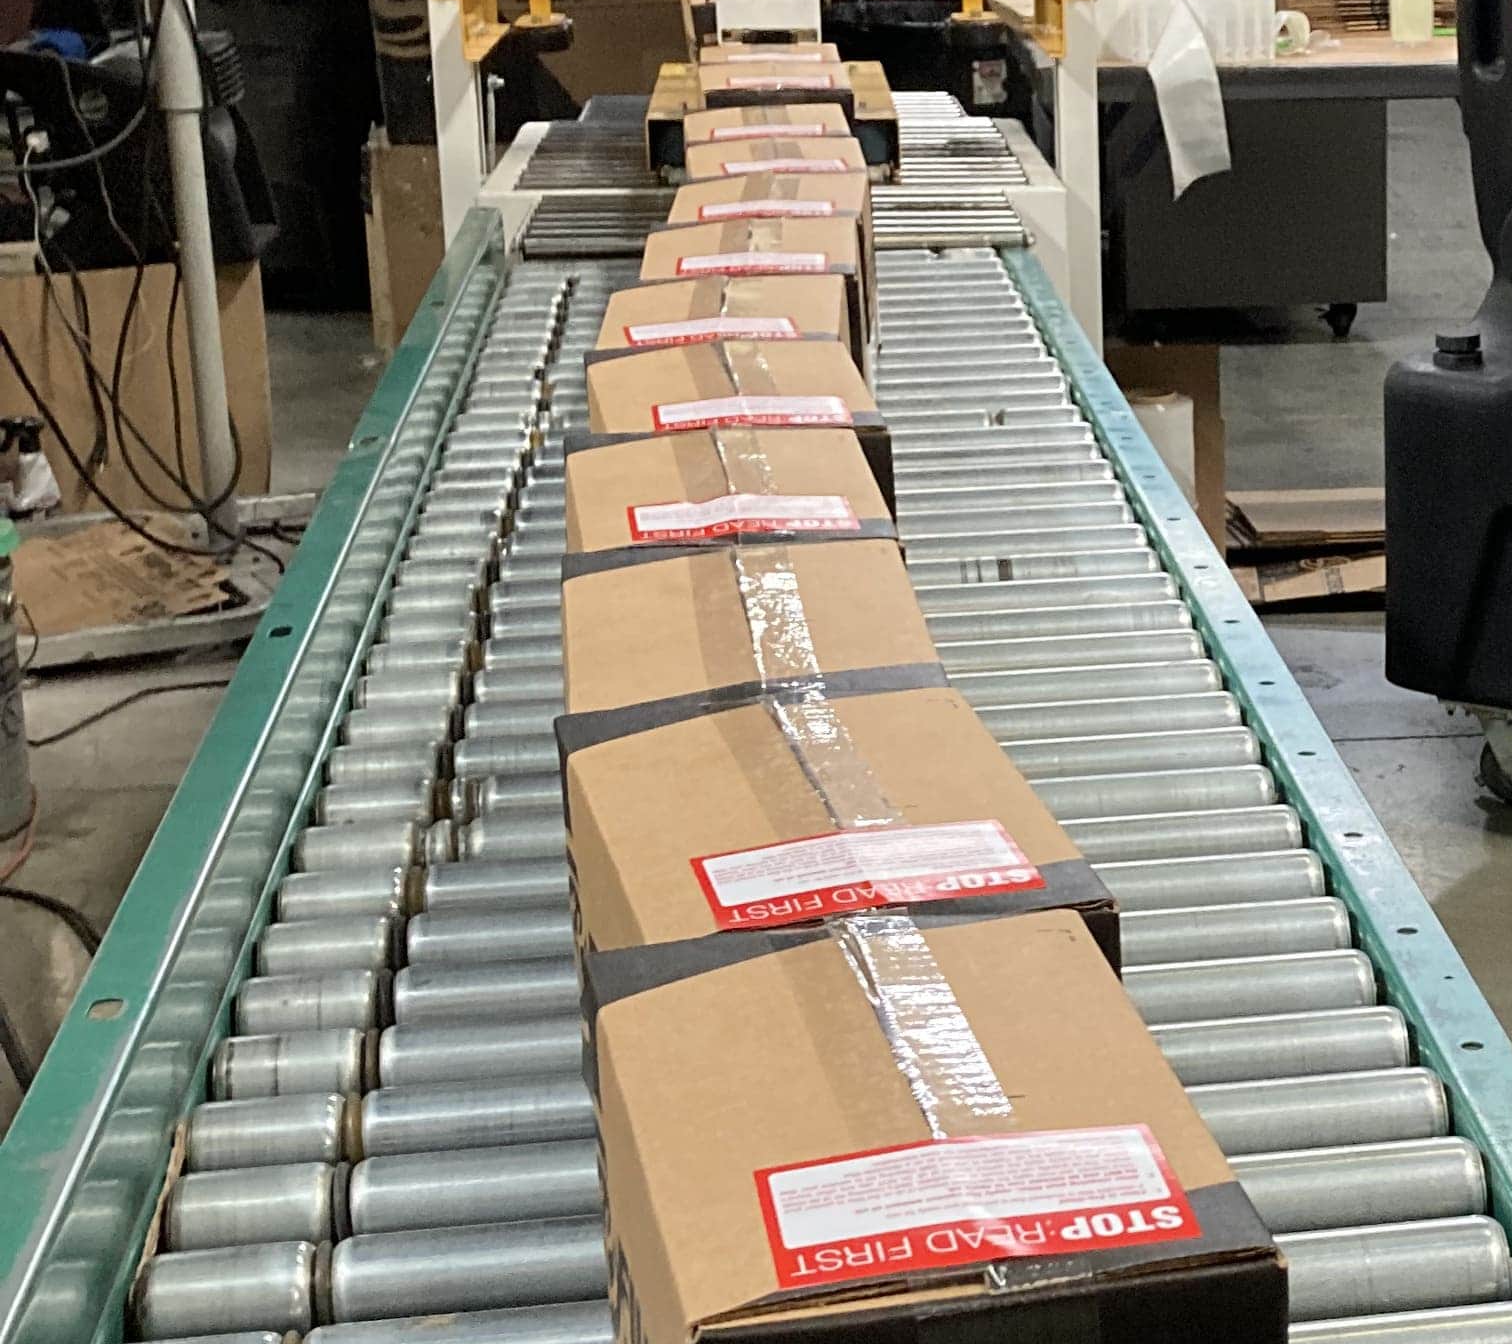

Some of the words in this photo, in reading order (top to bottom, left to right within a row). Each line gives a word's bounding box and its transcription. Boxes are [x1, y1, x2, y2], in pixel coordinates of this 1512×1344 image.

[728, 895, 824, 923] FIRST
[930, 1220, 1044, 1254] READ
[790, 1241, 913, 1278] FIRST
